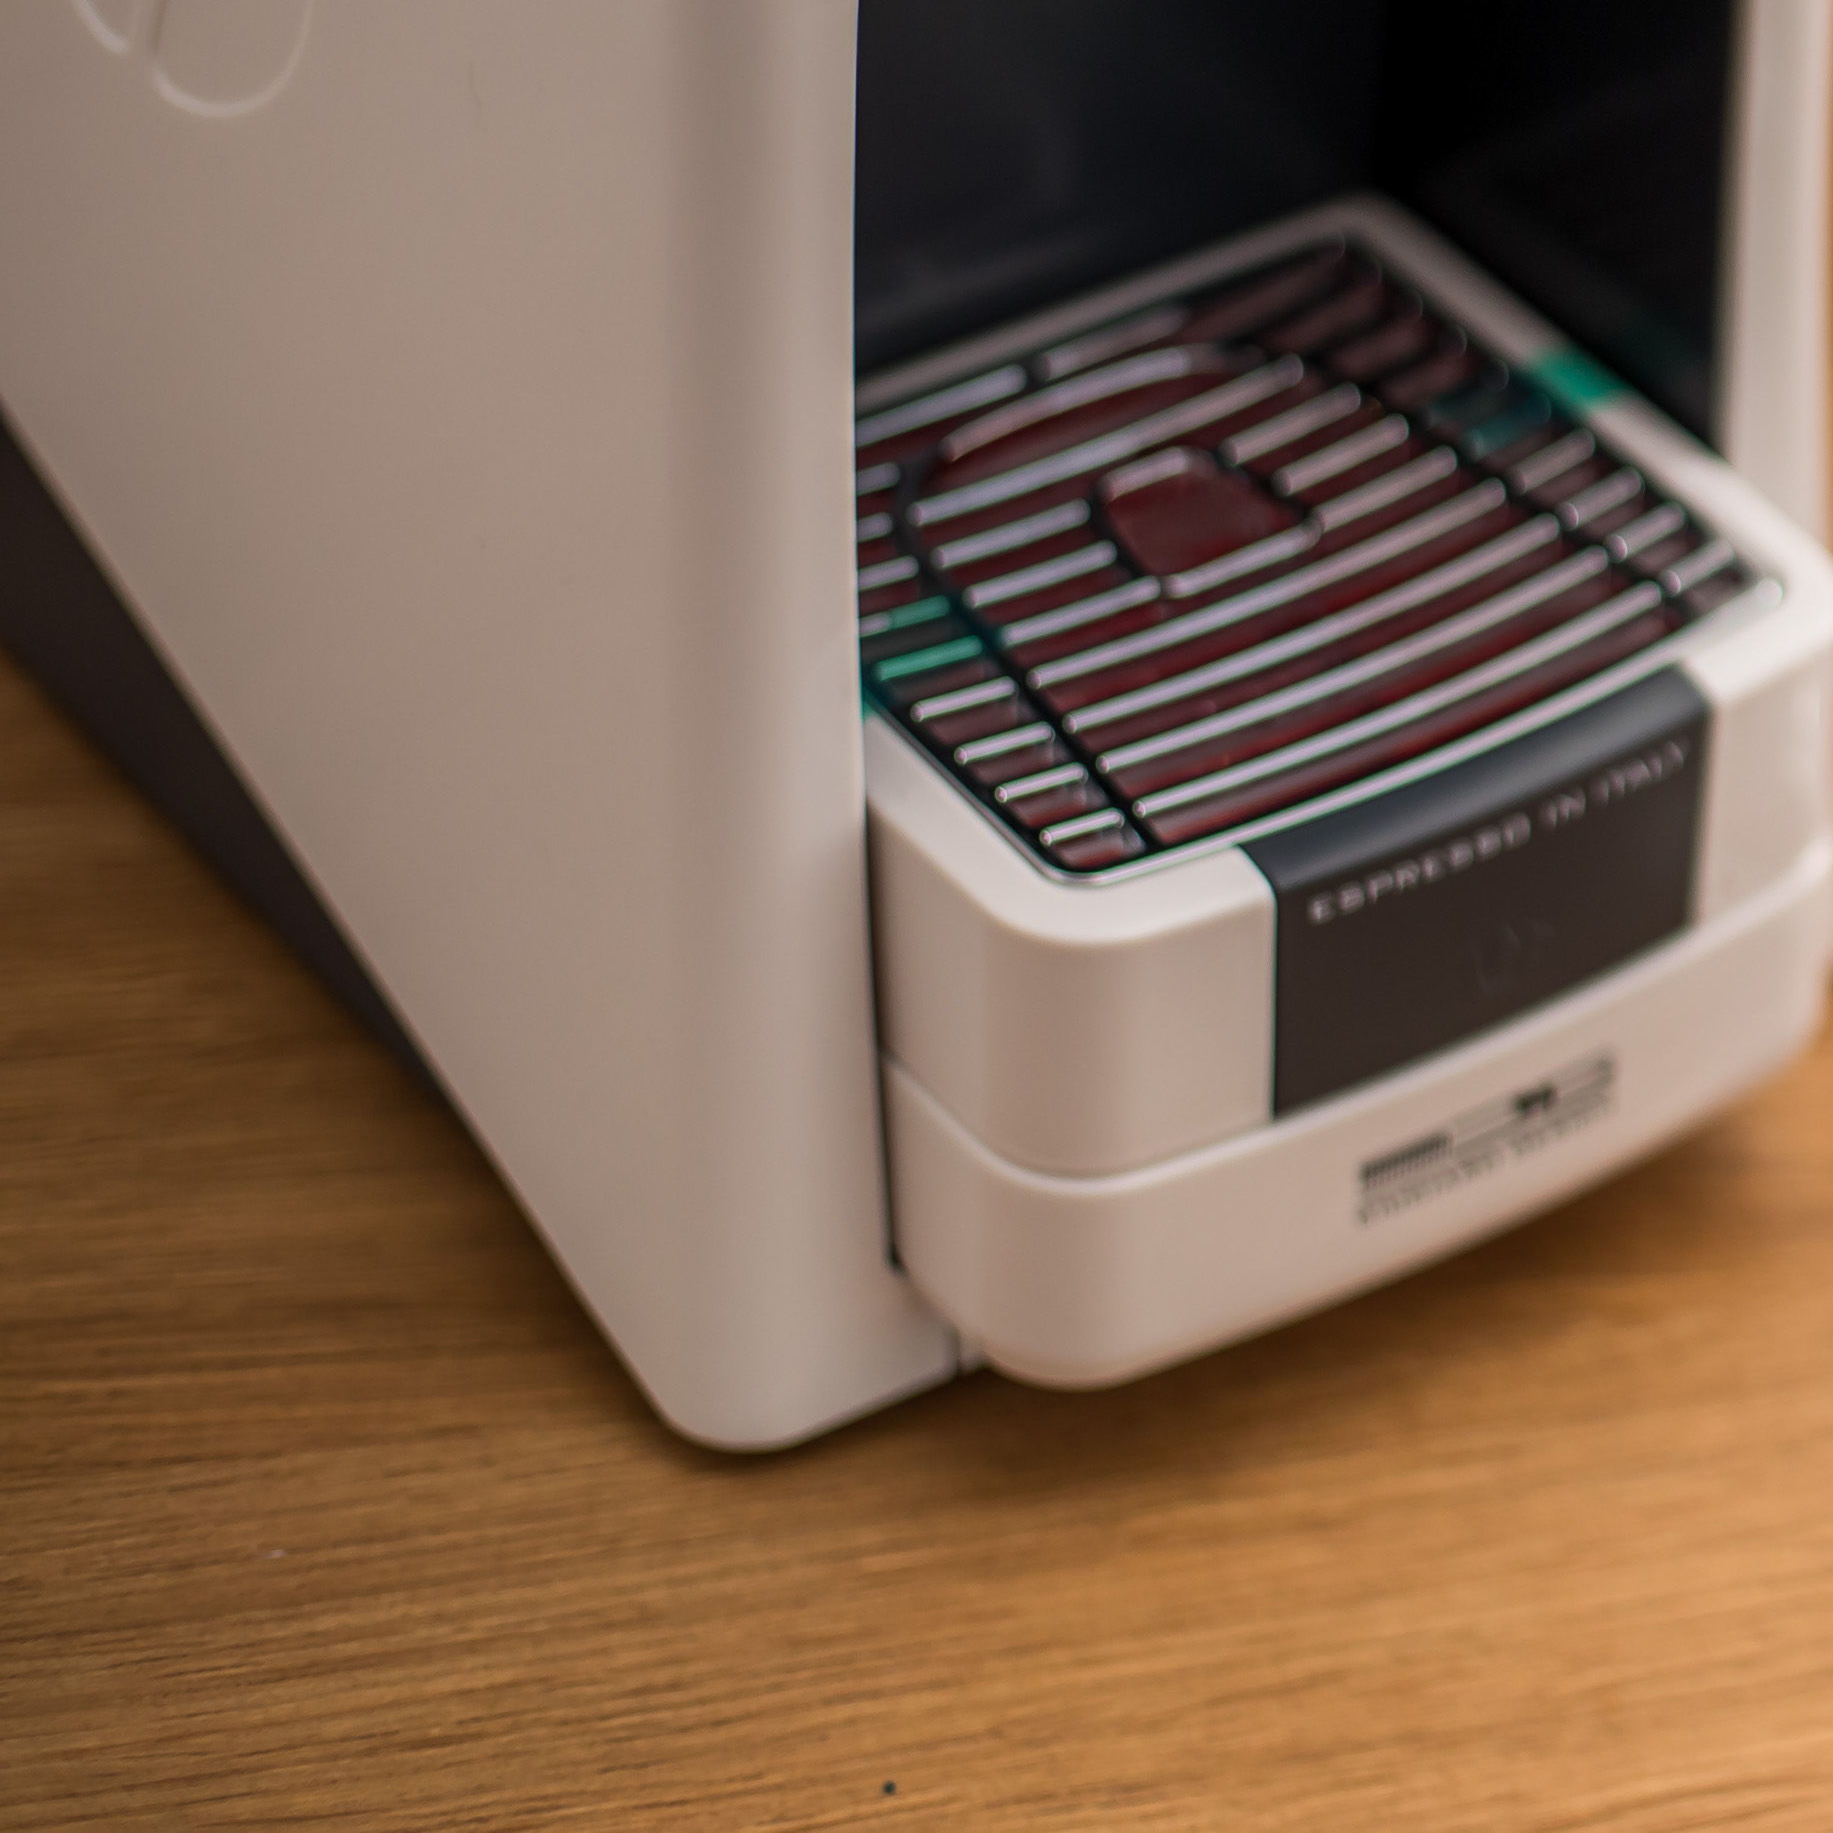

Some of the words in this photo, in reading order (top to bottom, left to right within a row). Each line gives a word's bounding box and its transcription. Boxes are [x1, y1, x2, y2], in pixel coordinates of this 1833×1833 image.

[1307, 812, 1532, 925] ESPRESSO
[1539, 787, 1587, 831] IN
[1590, 734, 1692, 807] ITALY
